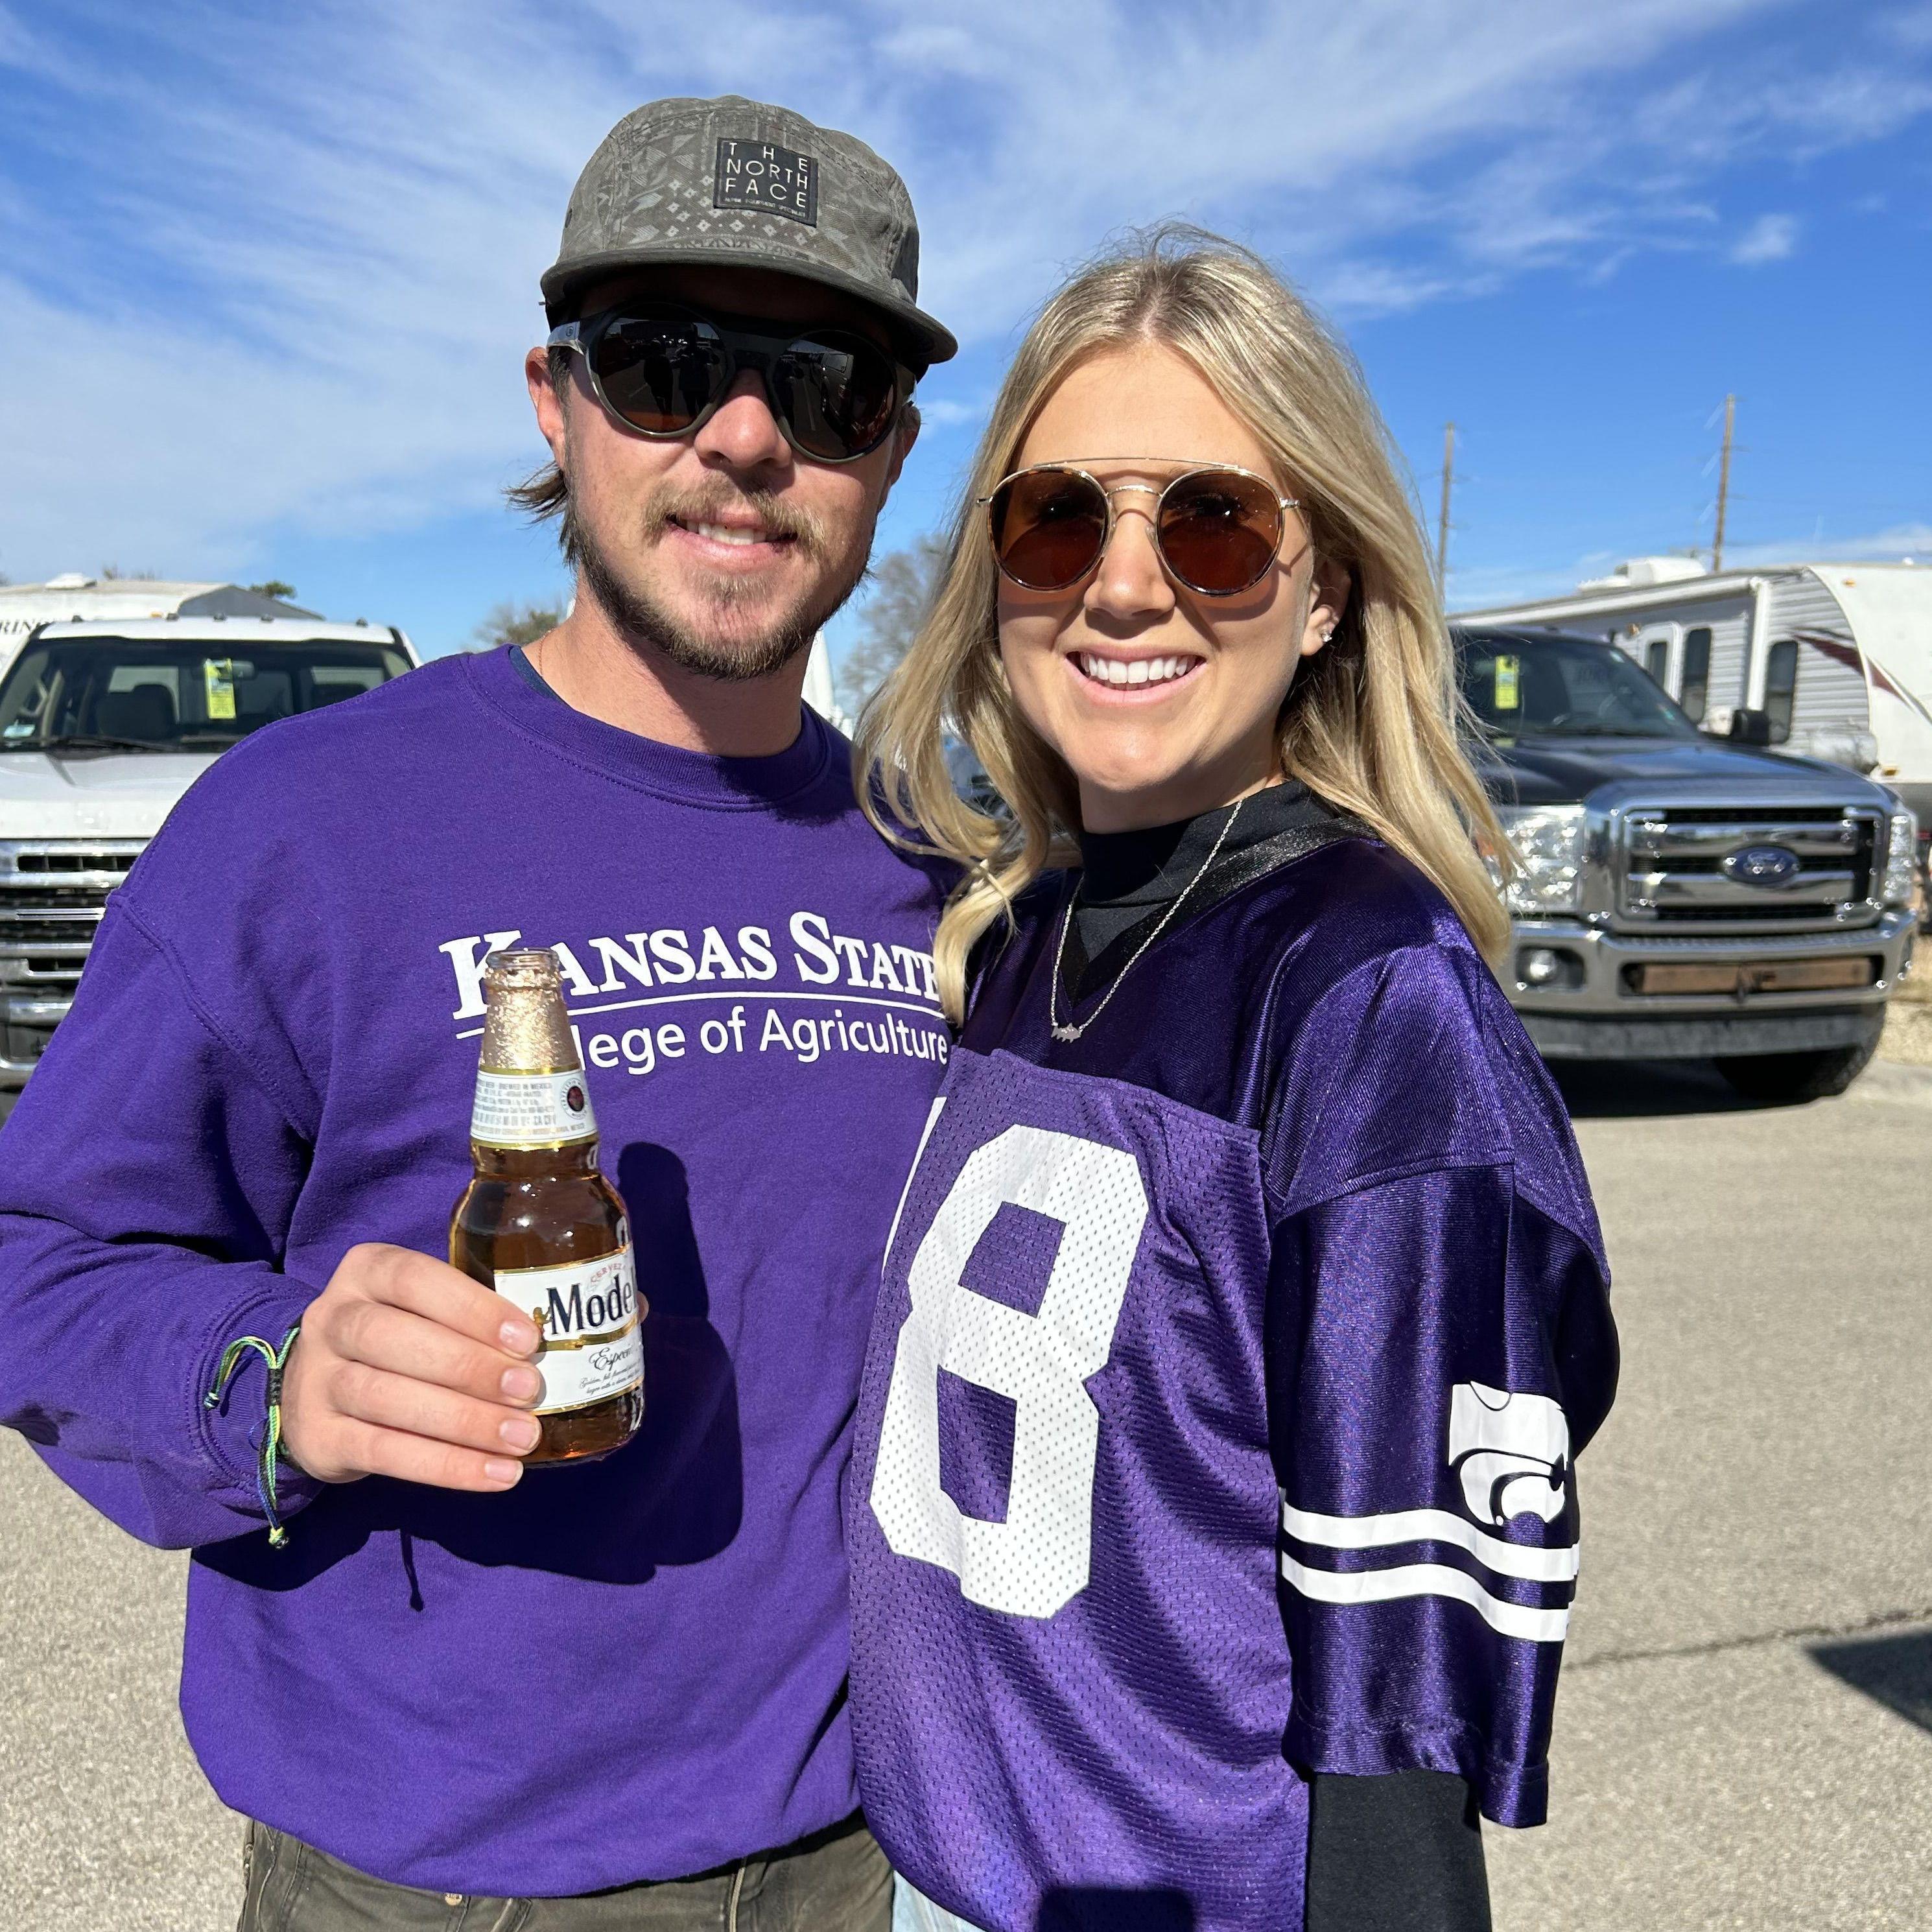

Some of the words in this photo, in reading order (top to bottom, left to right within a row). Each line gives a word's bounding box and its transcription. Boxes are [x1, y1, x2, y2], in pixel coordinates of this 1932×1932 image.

[726, 158, 808, 189] NORTH
[729, 143, 808, 172] THE
[725, 178, 807, 208] FACE
[438, 926, 777, 1020] KANSAS
[571, 1023, 685, 1075] lege
[700, 1006, 746, 1052] of
[759, 1008, 947, 1065] Agriculture
[869, 1096, 1148, 1619] 8
